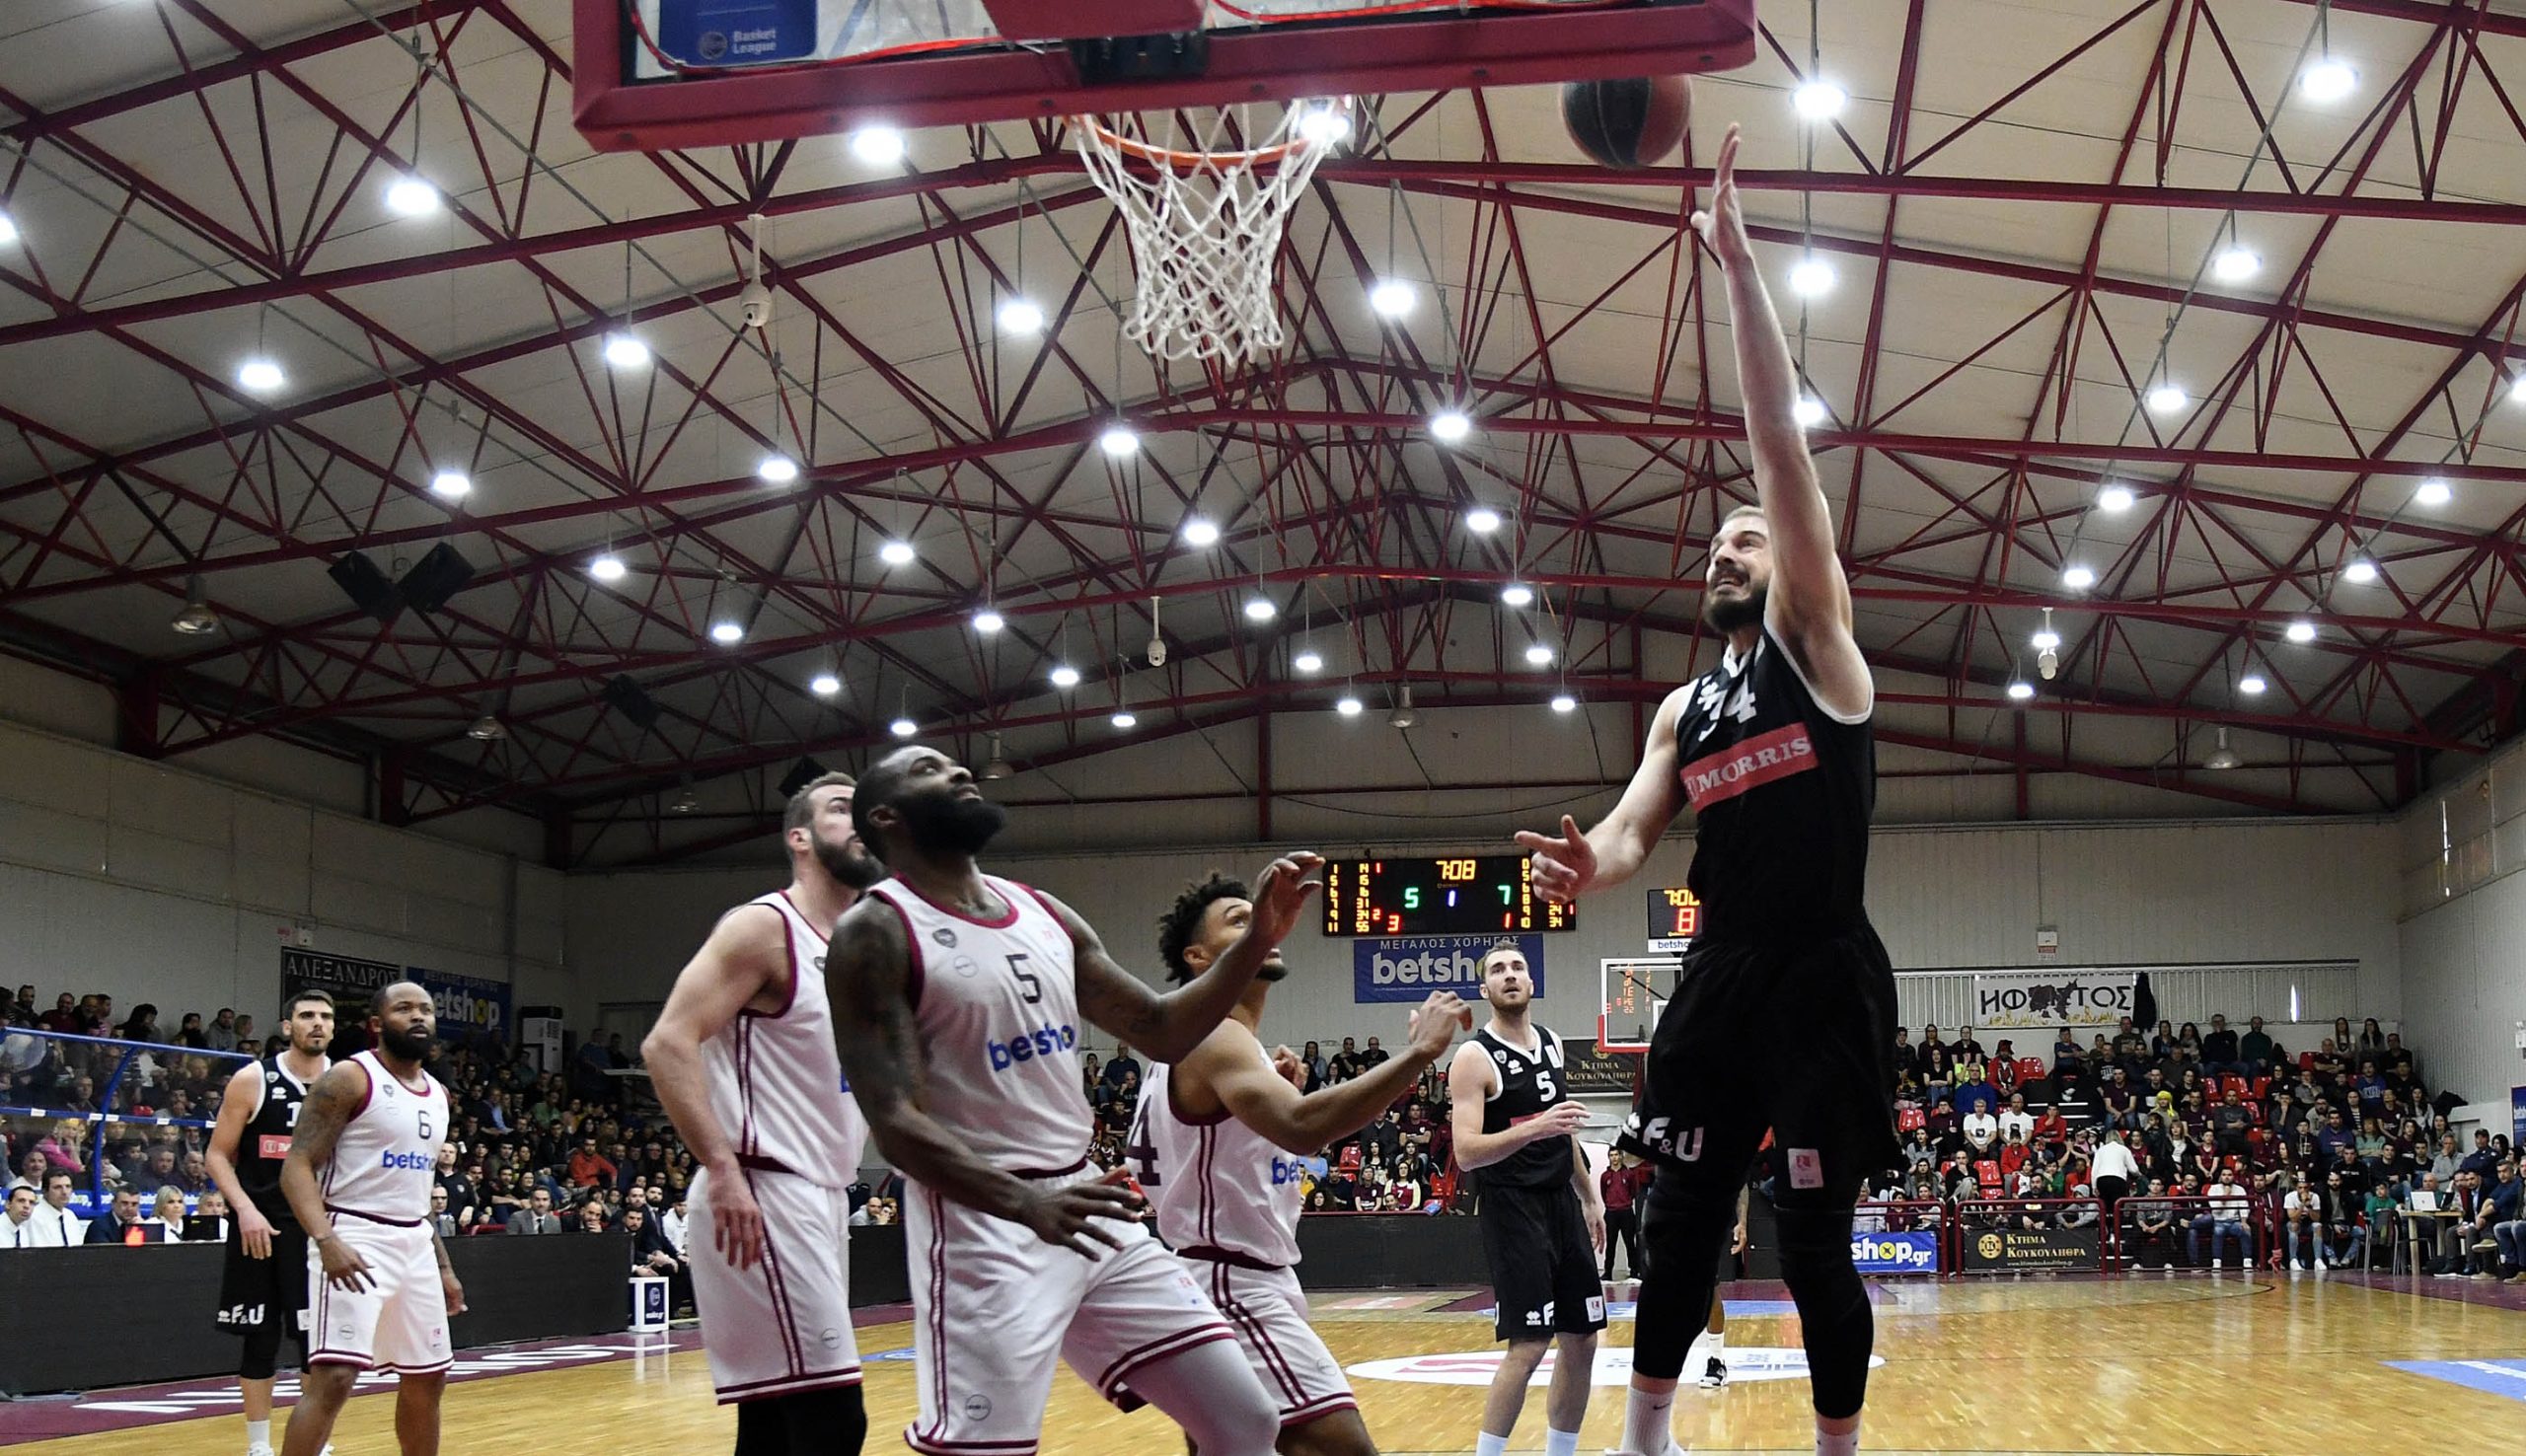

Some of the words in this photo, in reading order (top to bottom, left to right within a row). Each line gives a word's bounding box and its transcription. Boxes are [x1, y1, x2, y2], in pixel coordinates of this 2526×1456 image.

[733, 29, 777, 42] Basket
[733, 41, 777, 55] League
[1696, 736, 1813, 793] MORRIS
[1436, 859, 1476, 880] 7:08
[1329, 875, 1338, 886] 5
[1329, 887, 1338, 898] 6
[1404, 887, 1419, 909] 5
[1448, 890, 1455, 907] 1
[1497, 884, 1511, 906] 7
[1329, 910, 1338, 920] 9
[1373, 909, 1380, 920] 2
[1387, 915, 1399, 931] 3
[1504, 912, 1512, 929] 1
[1677, 908, 1695, 932] 8
[1380, 939, 1447, 950] ΜΕΓΑΛΟΣ
[1005, 953, 1042, 1004] 5
[420, 983, 500, 1032] etshop
[1536, 1070, 1556, 1102] 5
[417, 1110, 432, 1139] 6
[1642, 1116, 1704, 1162] F&U
[2006, 1233, 2046, 1244] ΚΤΗΜΑ
[2006, 1247, 2087, 1259] ΚΟΥΚΟΥΛΗΘΡΑ
[231, 1303, 265, 1325] F&U
